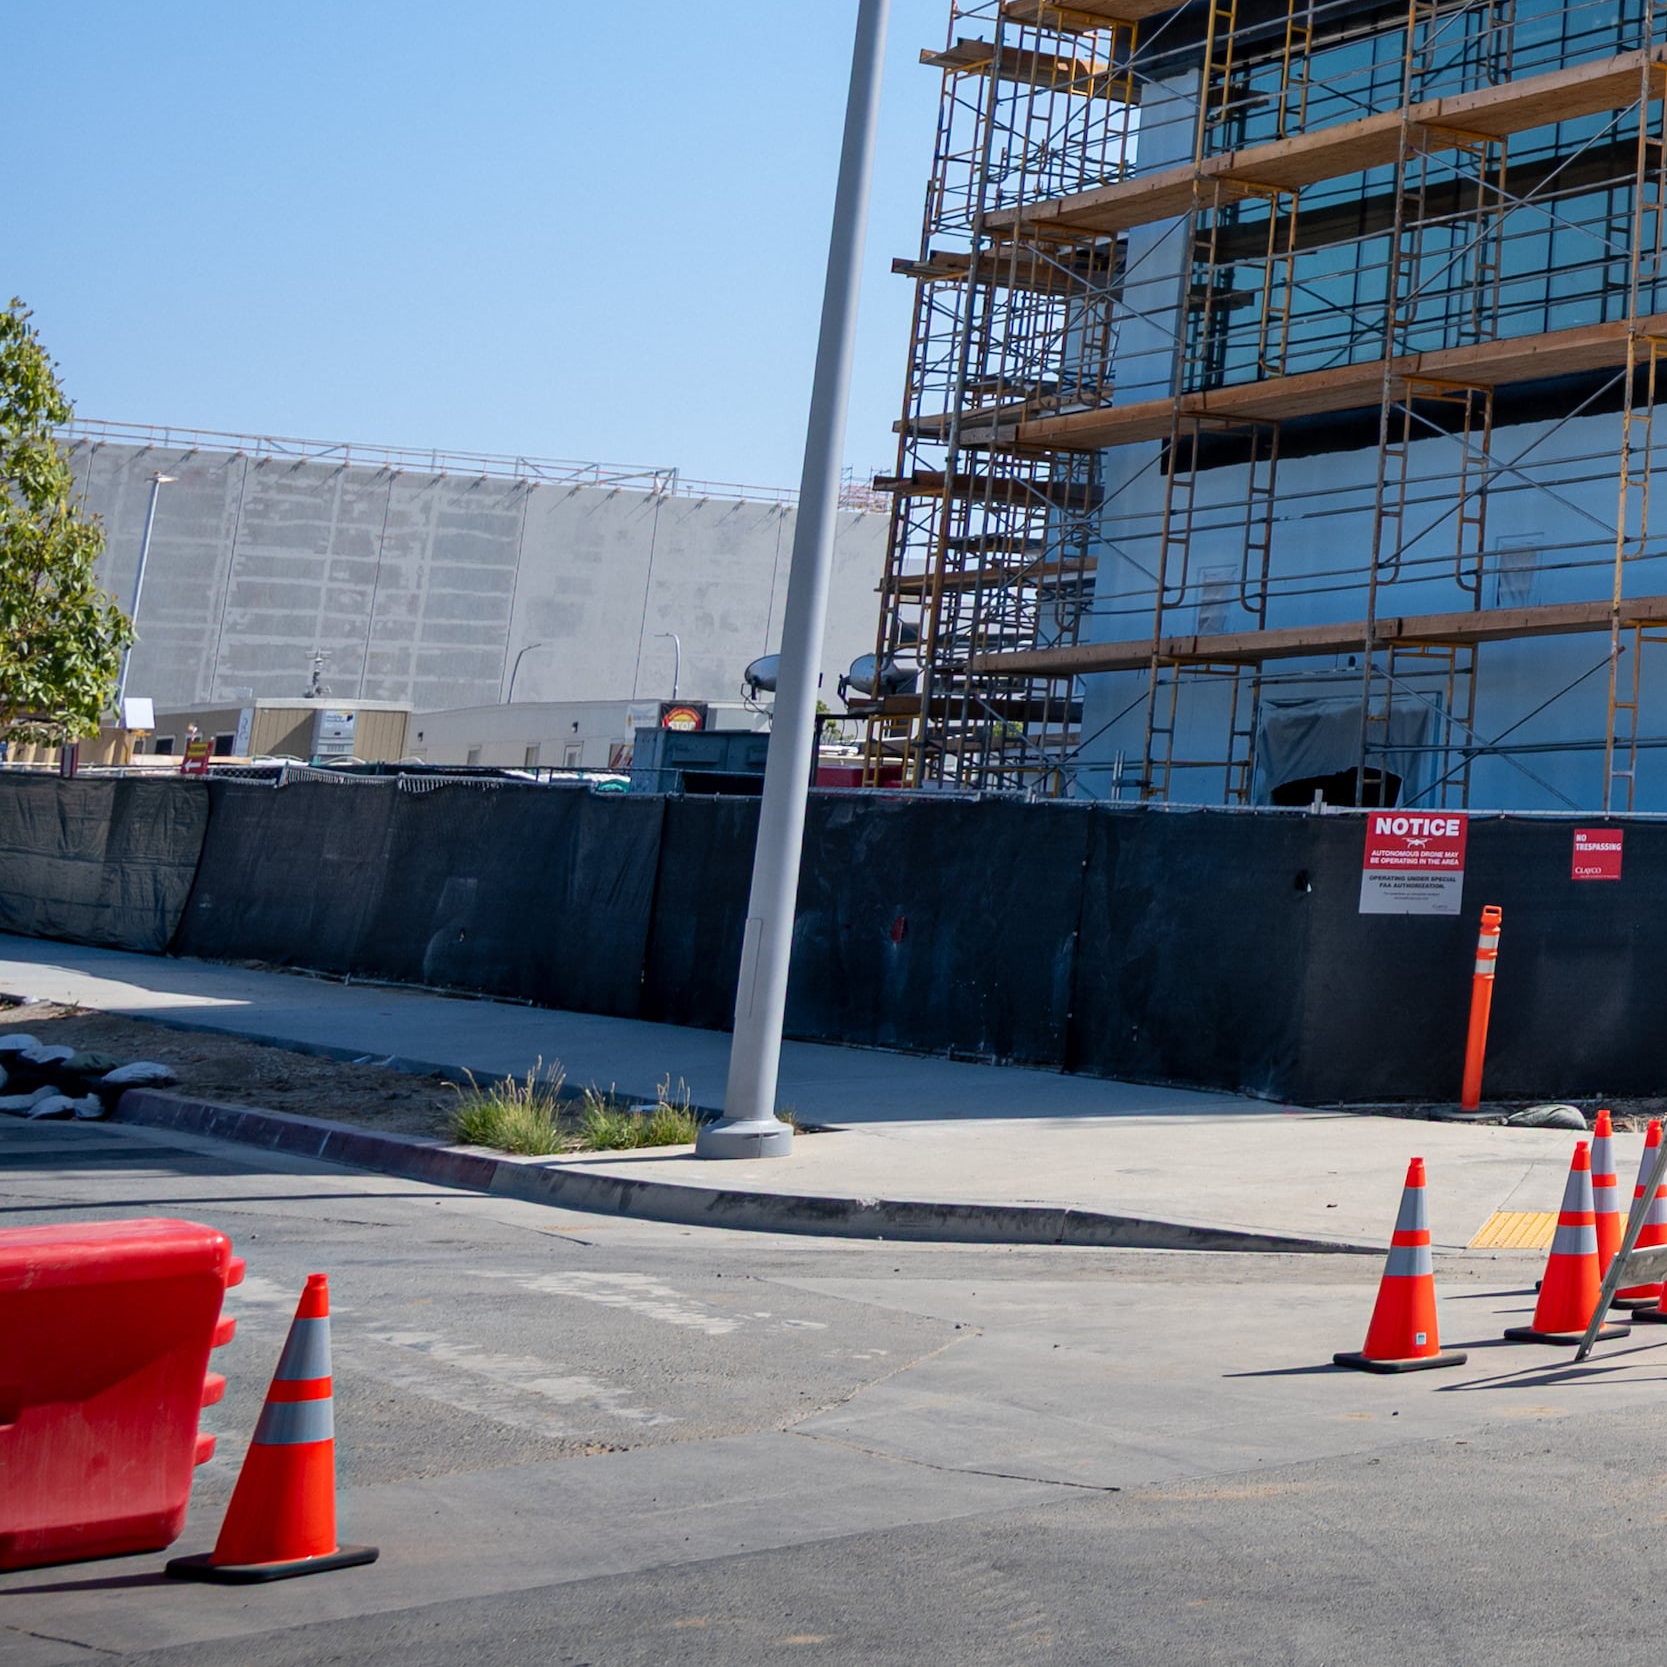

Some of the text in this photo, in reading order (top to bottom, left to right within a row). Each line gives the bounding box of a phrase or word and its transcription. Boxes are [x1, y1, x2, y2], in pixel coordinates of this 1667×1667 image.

[1375, 817, 1460, 836] NOTICE
[1576, 834, 1587, 842] NO
[1576, 843, 1621, 851] TRESPASSING
[1371, 850, 1459, 859] AUTONOMOUS DRONE MAY
[1380, 857, 1418, 865] OPERATING
[1575, 867, 1602, 875] CLAYCO
